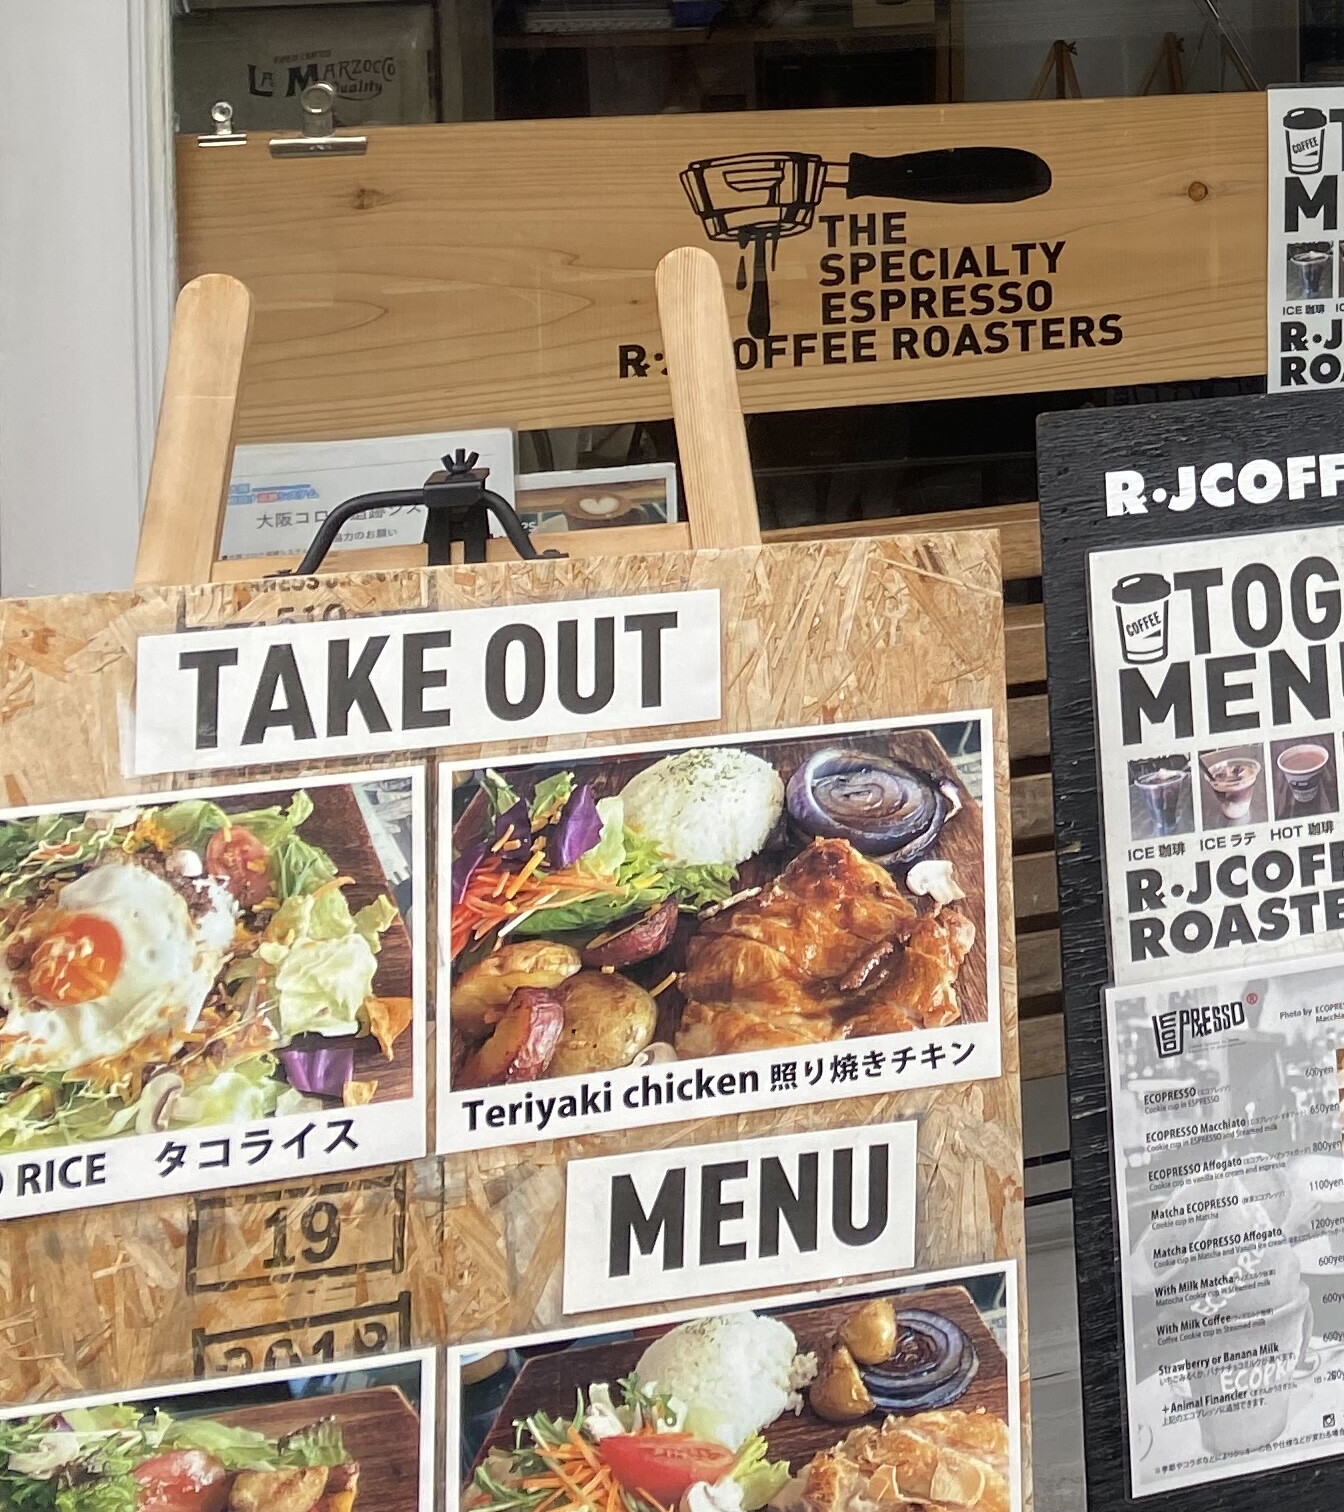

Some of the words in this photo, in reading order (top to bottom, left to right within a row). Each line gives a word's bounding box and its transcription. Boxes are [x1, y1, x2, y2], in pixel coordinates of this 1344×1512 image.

[819, 211, 907, 247] THE
[819, 240, 1066, 287] SPECIALTY
[821, 280, 1053, 326] ESPRESSO
[1282, 304, 1303, 315] ICE
[892, 313, 1124, 361] ROASTERS
[1125, 611, 1162, 638] COFFEE
[179, 628, 452, 751] TAKE
[483, 610, 680, 717] OUT
[1127, 846, 1155, 861] ICE
[1158, 842, 1185, 857] 珈琲
[1199, 836, 1226, 852] ICE
[1230, 831, 1257, 848] ラテ
[1269, 824, 1303, 842] HOT
[1307, 821, 1334, 837] 珈琲
[462, 1079, 612, 1132] Teriyaki
[622, 1065, 759, 1109] chicken
[770, 1042, 975, 1092] 照り焼きチキン
[1143, 1087, 1196, 1106] ECOPRESSO
[1146, 1125, 1199, 1143] ECOPRESSO
[1200, 1117, 1246, 1136] Macchiato
[17, 1152, 107, 1197] RICE
[155, 1118, 359, 1178] タコライス
[1148, 1164, 1200, 1182] ECOPRESSO
[608, 1142, 890, 1279] MENU
[1151, 1205, 1184, 1220] Matcha
[1186, 1195, 1239, 1213] ECOPRESSO
[263, 1201, 341, 1269] 19
[1153, 1245, 1187, 1259] Matcha
[1188, 1234, 1241, 1253] ECOPRESSO
[1155, 1285, 1177, 1298] With
[1178, 1280, 1198, 1293] Milk
[1200, 1275, 1234, 1290] Matcha
[1156, 1322, 1179, 1336] With
[1181, 1317, 1200, 1330] Milk
[1202, 1313, 1231, 1328] Coffee
[1159, 1357, 1209, 1376] Strawberry
[1211, 1355, 1222, 1365] or
[1224, 1348, 1258, 1362] Banana
[1259, 1343, 1279, 1356] Milk
